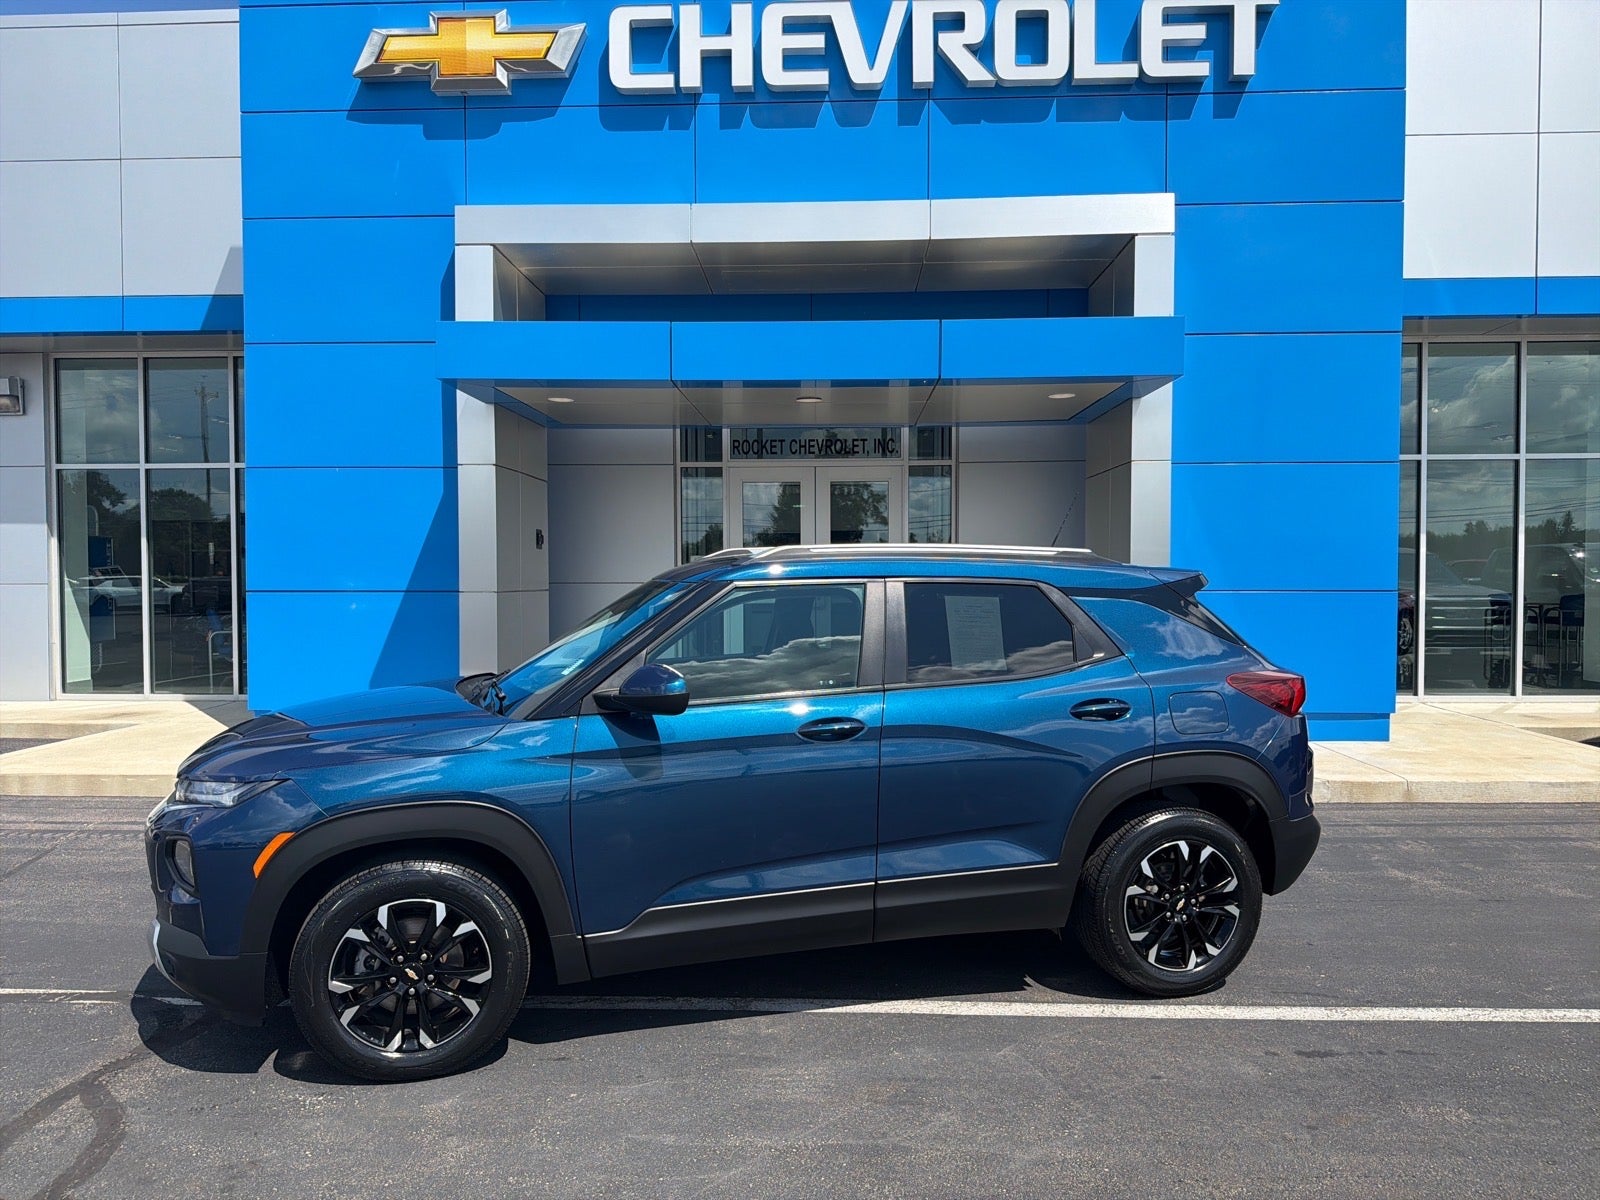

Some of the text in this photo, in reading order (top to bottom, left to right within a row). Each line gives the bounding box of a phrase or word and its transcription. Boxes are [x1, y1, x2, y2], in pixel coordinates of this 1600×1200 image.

[608, 0, 1279, 95] CHEVROLET
[732, 438, 899, 456] ROCKET CHEVROLET, INC.
